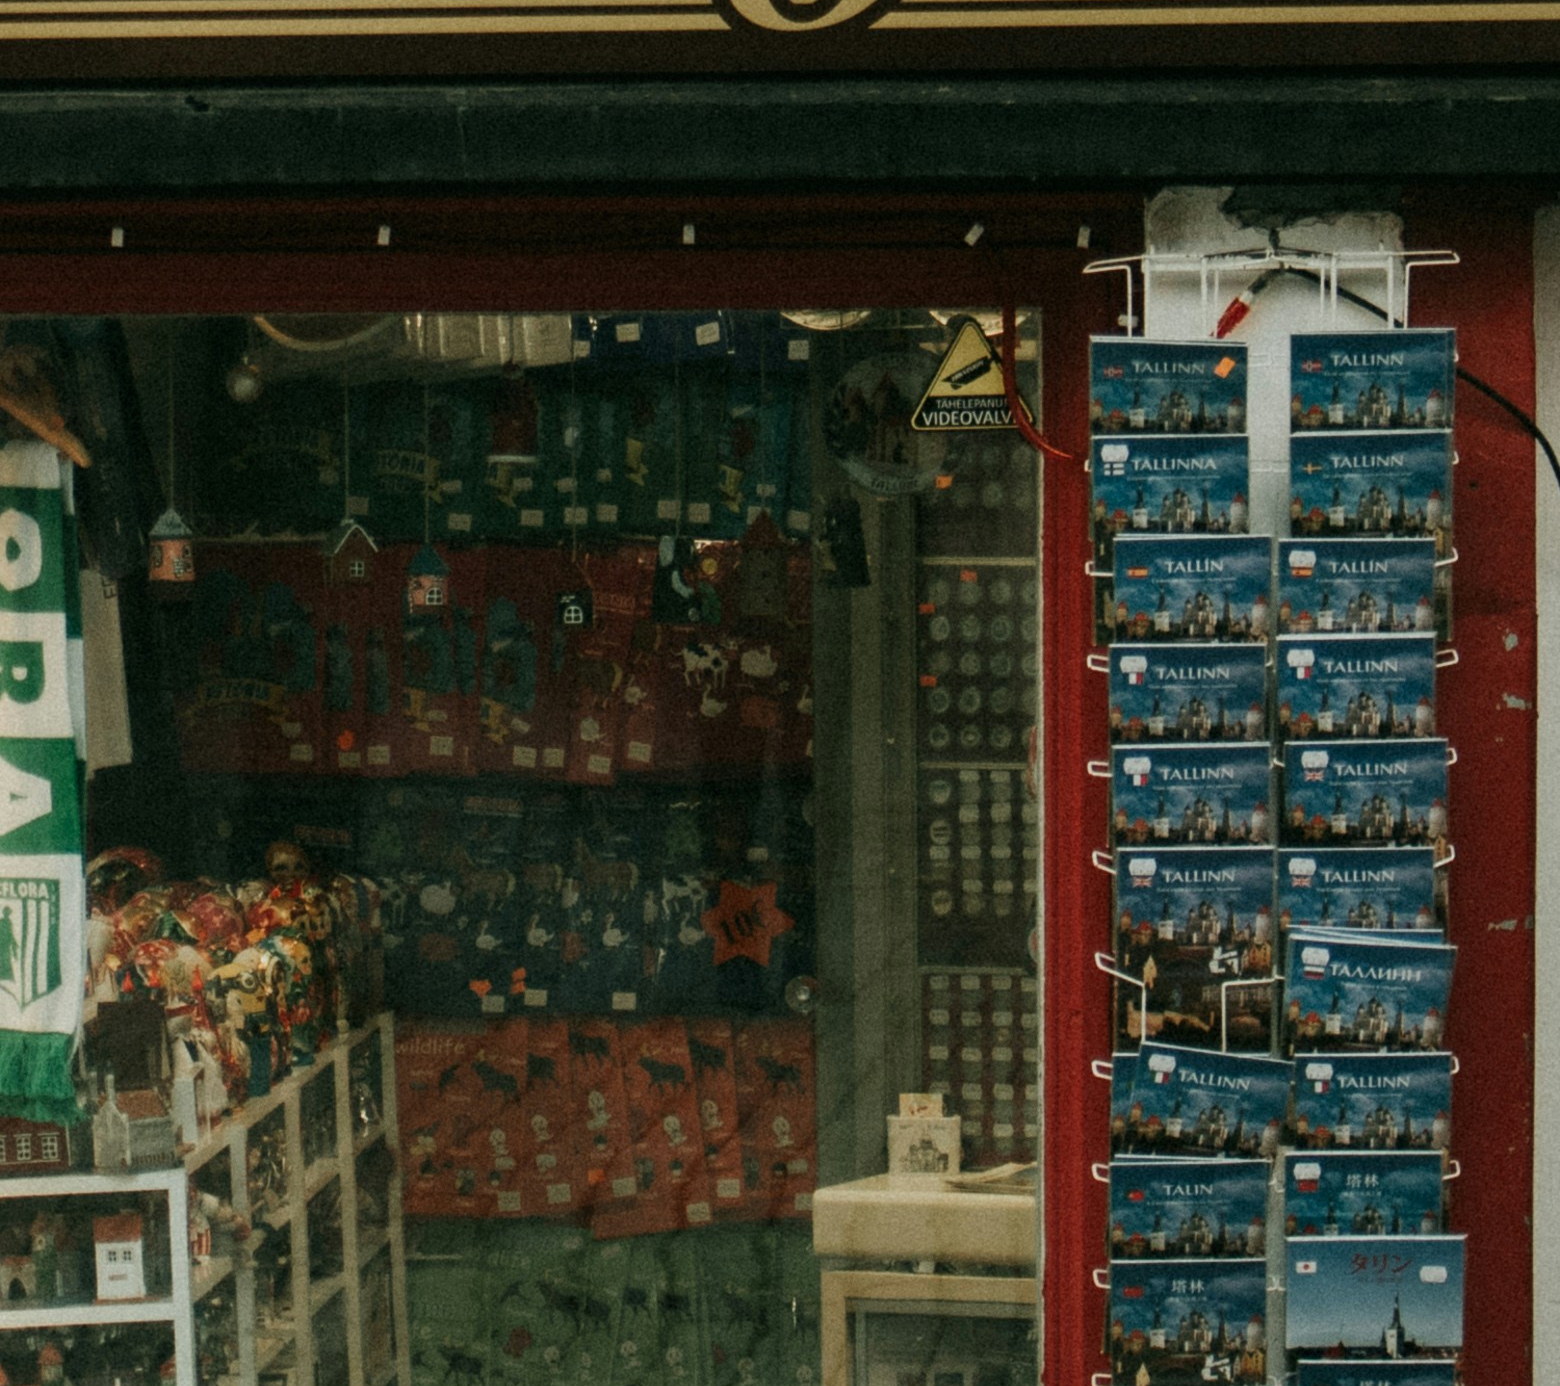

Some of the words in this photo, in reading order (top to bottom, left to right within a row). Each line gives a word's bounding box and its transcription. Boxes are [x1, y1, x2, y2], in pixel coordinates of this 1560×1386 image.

[1332, 353, 1404, 367] TALLINN
[1132, 361, 1205, 375] TALLINN
[922, 411, 1013, 426] VIDEOVALV
[1132, 457, 1217, 472] TALLINNA
[1332, 454, 1404, 469] TALLINN
[1157, 666, 1230, 681] TALLINN
[1323, 660, 1398, 675] TALLINN
[1162, 766, 1234, 781] TALLINN
[1335, 763, 1408, 777] TALLINN
[1163, 869, 1235, 883] TALLINN
[1322, 869, 1395, 883] TALLINN
[1331, 962, 1422, 982] ТАЛЛИНН
[1179, 1070, 1251, 1091] TALLINN
[1338, 1075, 1410, 1090] TALLINN
[1345, 1173, 1380, 1188] 塔林
[1162, 1184, 1214, 1196] TALIN
[1351, 1252, 1414, 1273] タリン
[1171, 1279, 1206, 1294] 塔林
